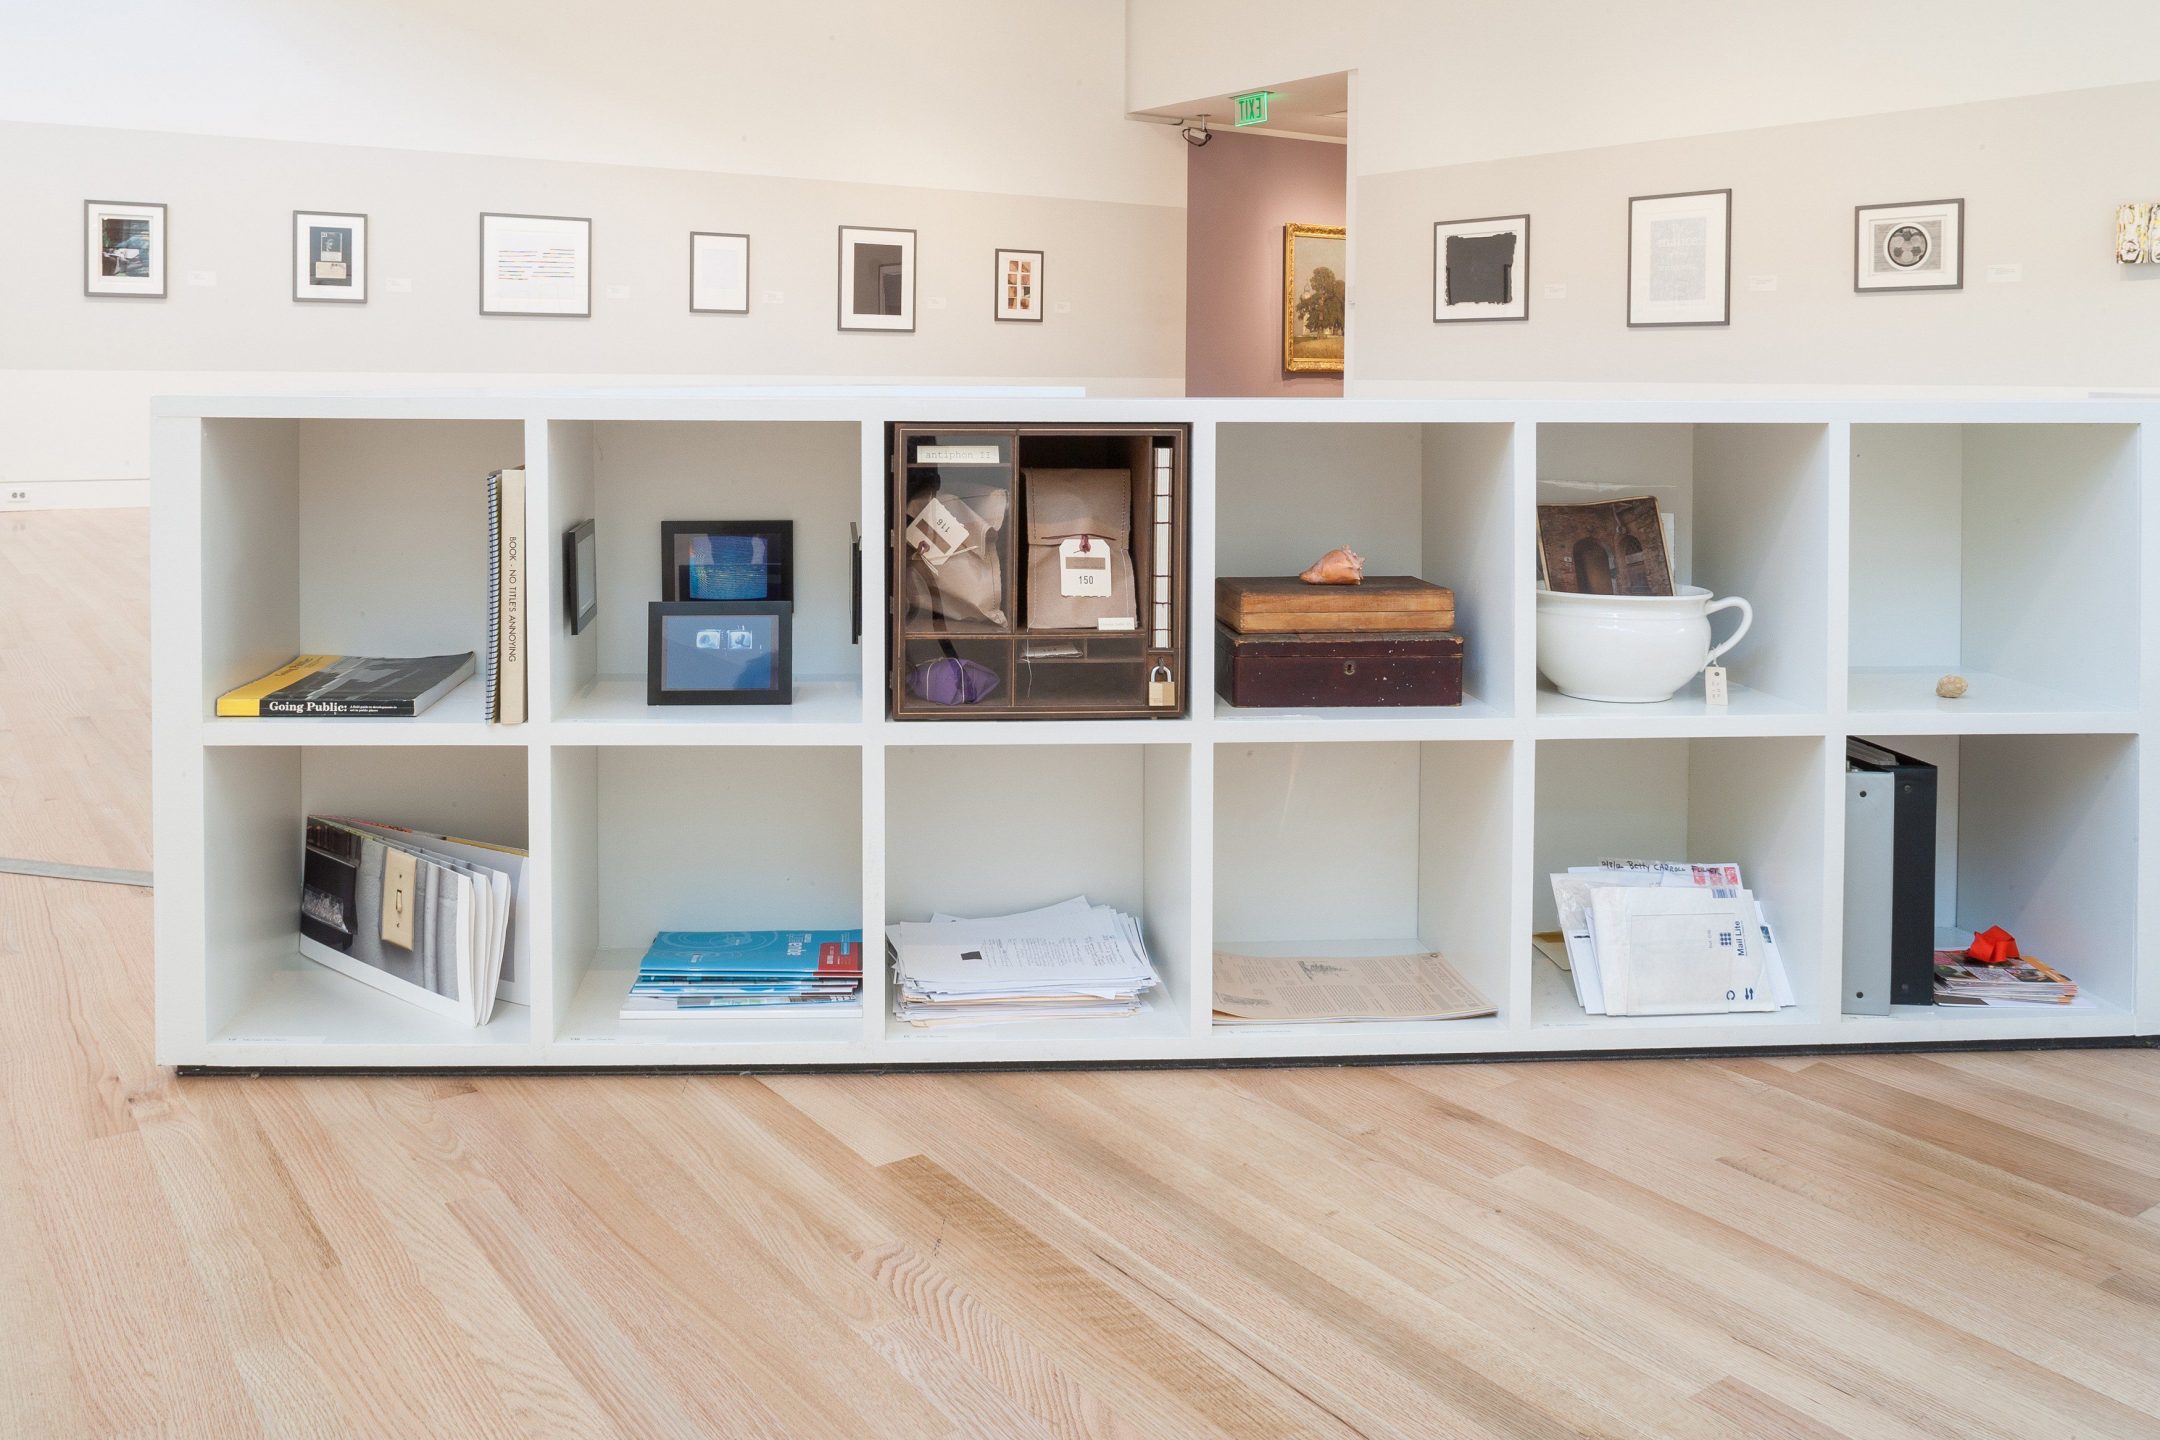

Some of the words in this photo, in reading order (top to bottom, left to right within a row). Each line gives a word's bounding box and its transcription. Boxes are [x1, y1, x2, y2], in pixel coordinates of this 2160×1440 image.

[509, 536, 517, 561] BOOK
[509, 569, 517, 584] NO
[1079, 575, 1094, 585] 150
[509, 615, 517, 662] ANNOYING
[269, 701, 304, 714] Going
[306, 701, 347, 712] Public:
[1734, 920, 1742, 936] Lite
[1736, 938, 1745, 956] Mail
